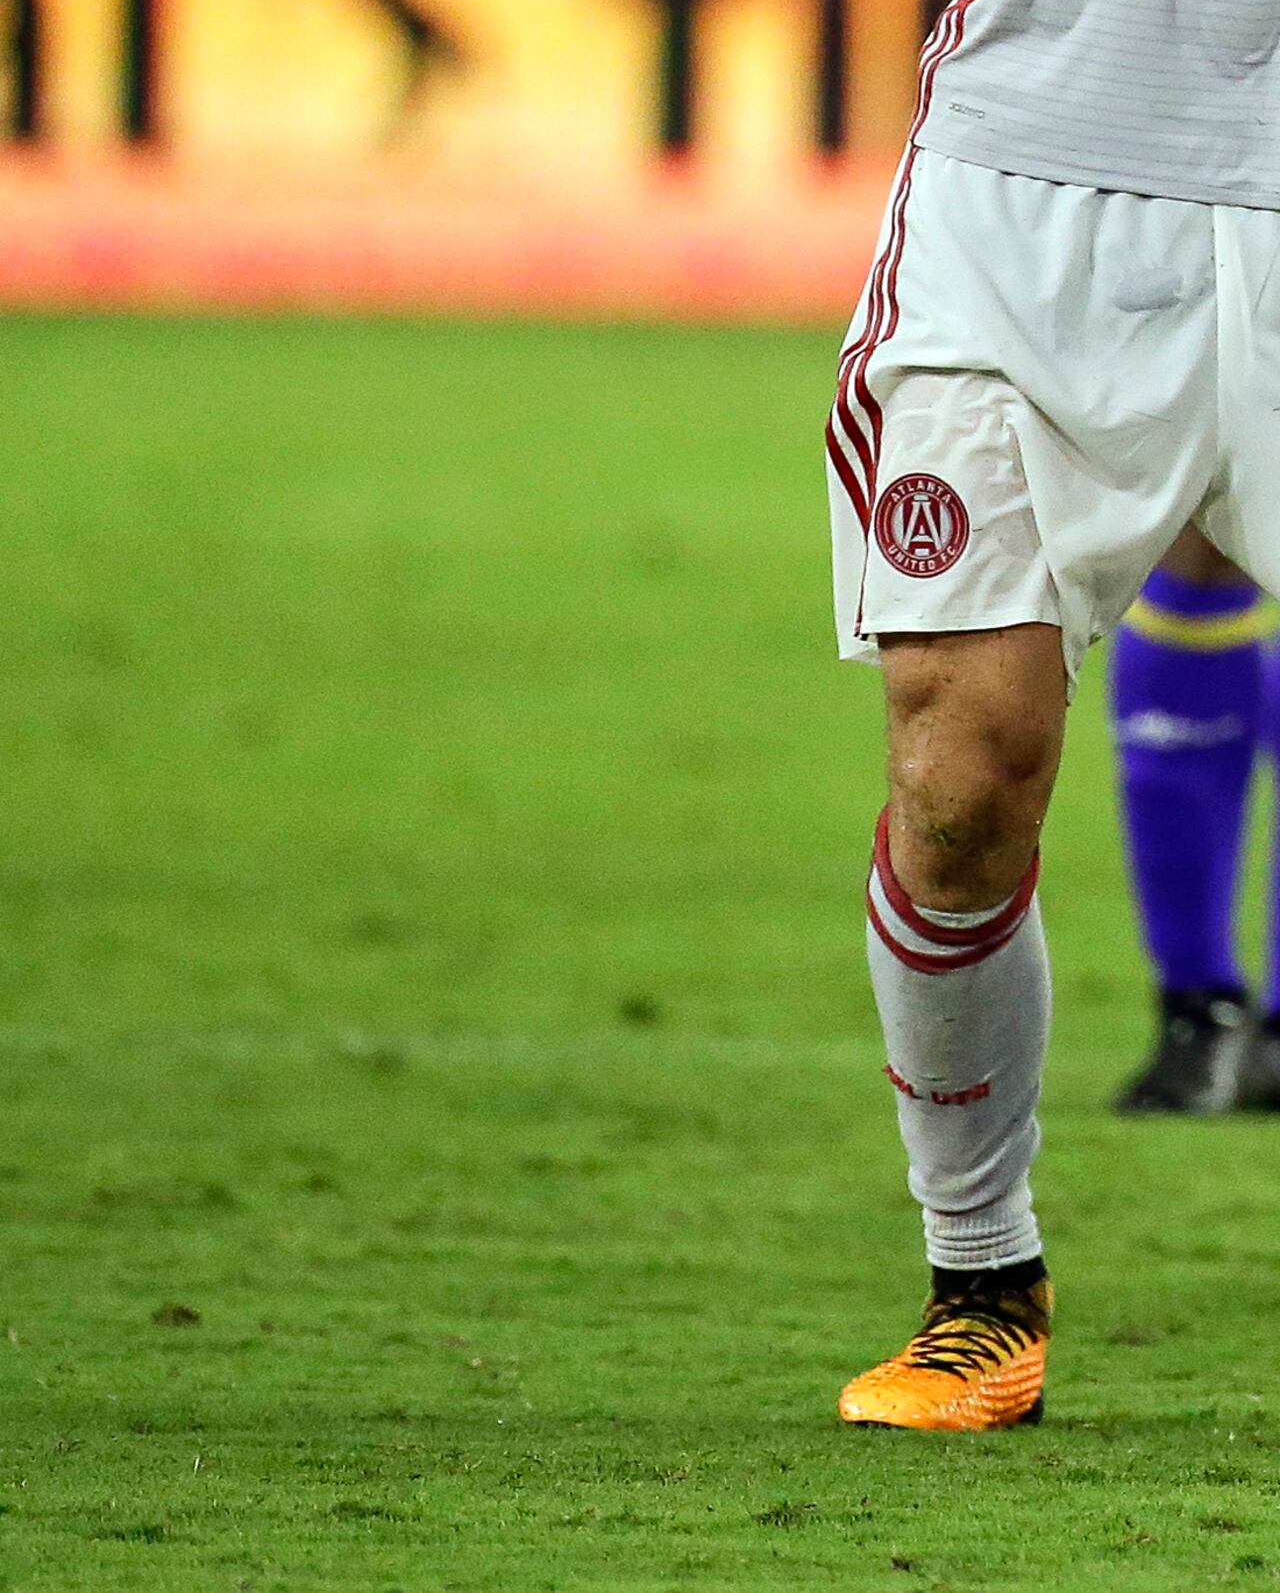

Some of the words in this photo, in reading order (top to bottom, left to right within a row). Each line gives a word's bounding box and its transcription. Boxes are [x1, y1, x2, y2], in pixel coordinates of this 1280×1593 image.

[890, 480, 952, 504] ATLANTA
[888, 544, 937, 572] UNITED
[940, 545, 956, 564] FC
